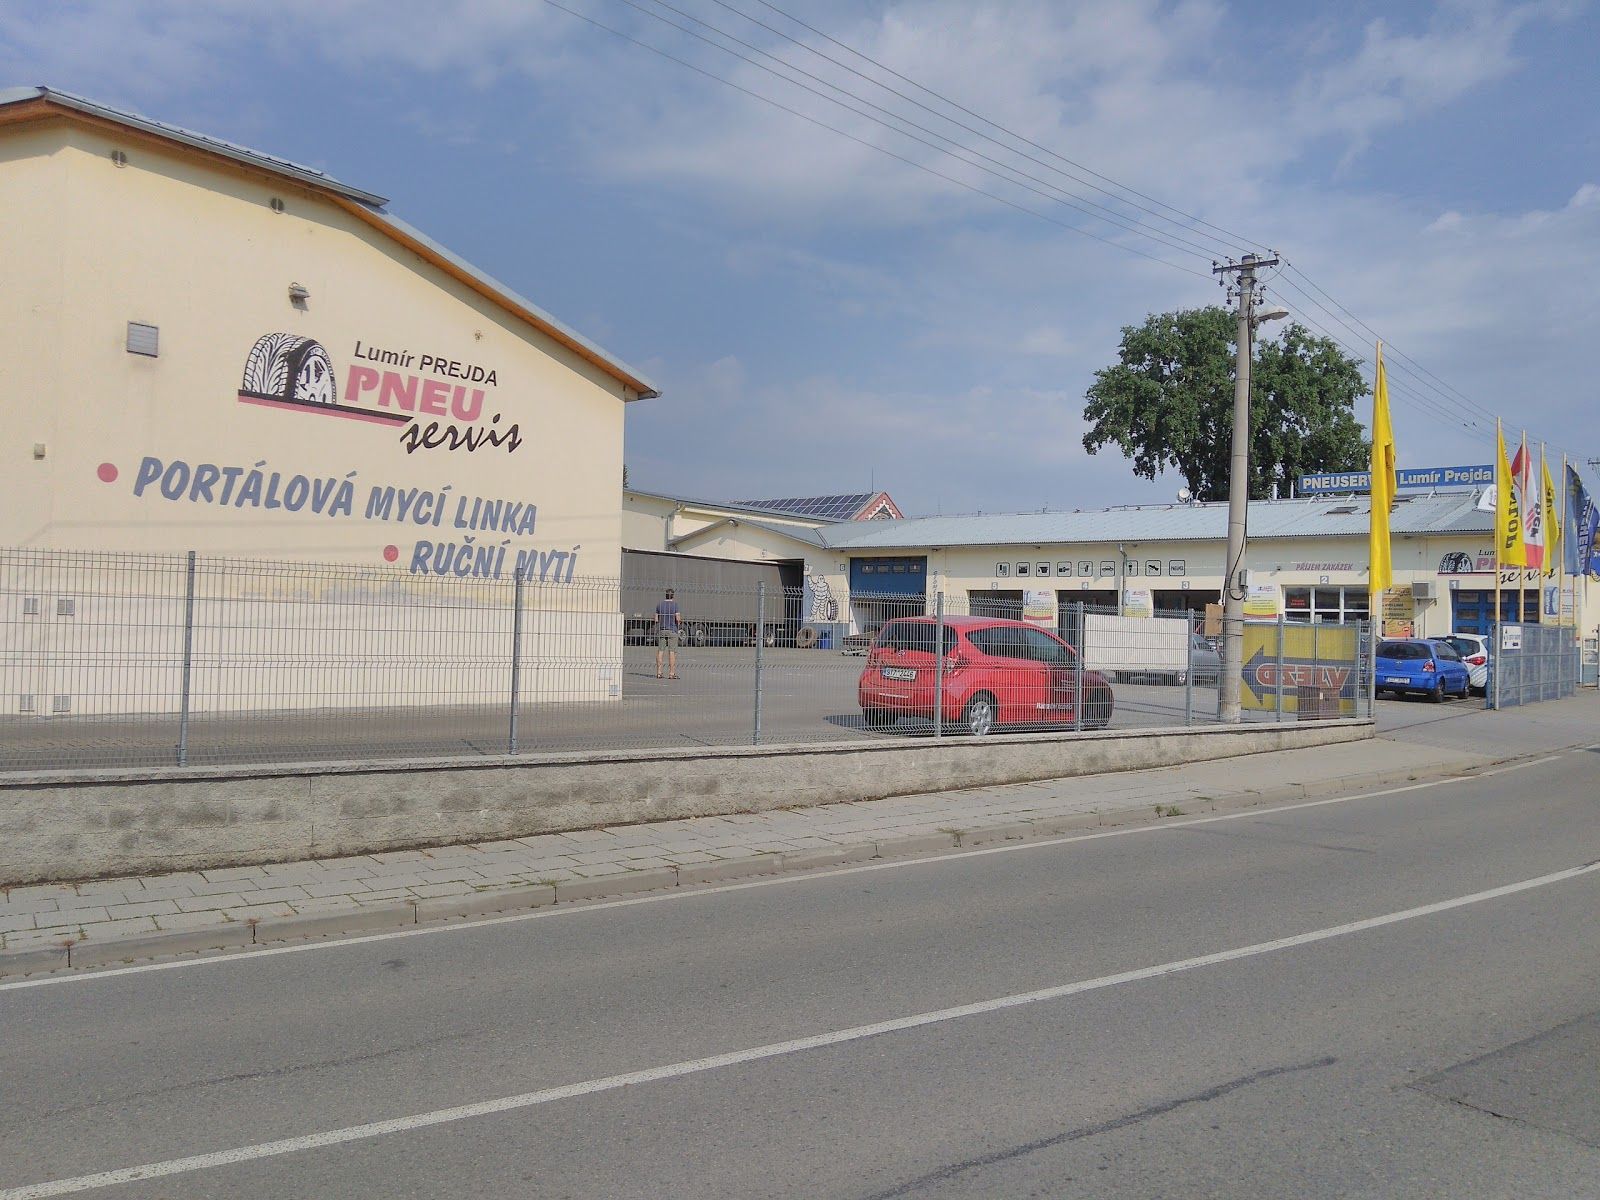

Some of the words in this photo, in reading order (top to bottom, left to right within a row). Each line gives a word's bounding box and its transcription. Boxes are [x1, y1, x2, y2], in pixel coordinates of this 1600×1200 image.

[354, 340, 414, 368] Lumír
[419, 354, 498, 386] PREJDA
[344, 364, 486, 422] PNEU
[400, 413, 523, 454] servis
[1399, 470, 1441, 484] Lumír
[1444, 468, 1492, 483] Prejda
[133, 456, 358, 518] PORTÁLOVÁ
[364, 485, 453, 527] MYCÍ
[453, 495, 537, 536] LINKA
[409, 536, 511, 580] RUČNÍ
[514, 544, 581, 584] MYTÍ
[992, 582, 998, 590] 5
[1082, 582, 1088, 590] 4
[1183, 581, 1189, 590] 3
[1320, 576, 1328, 584] 2
